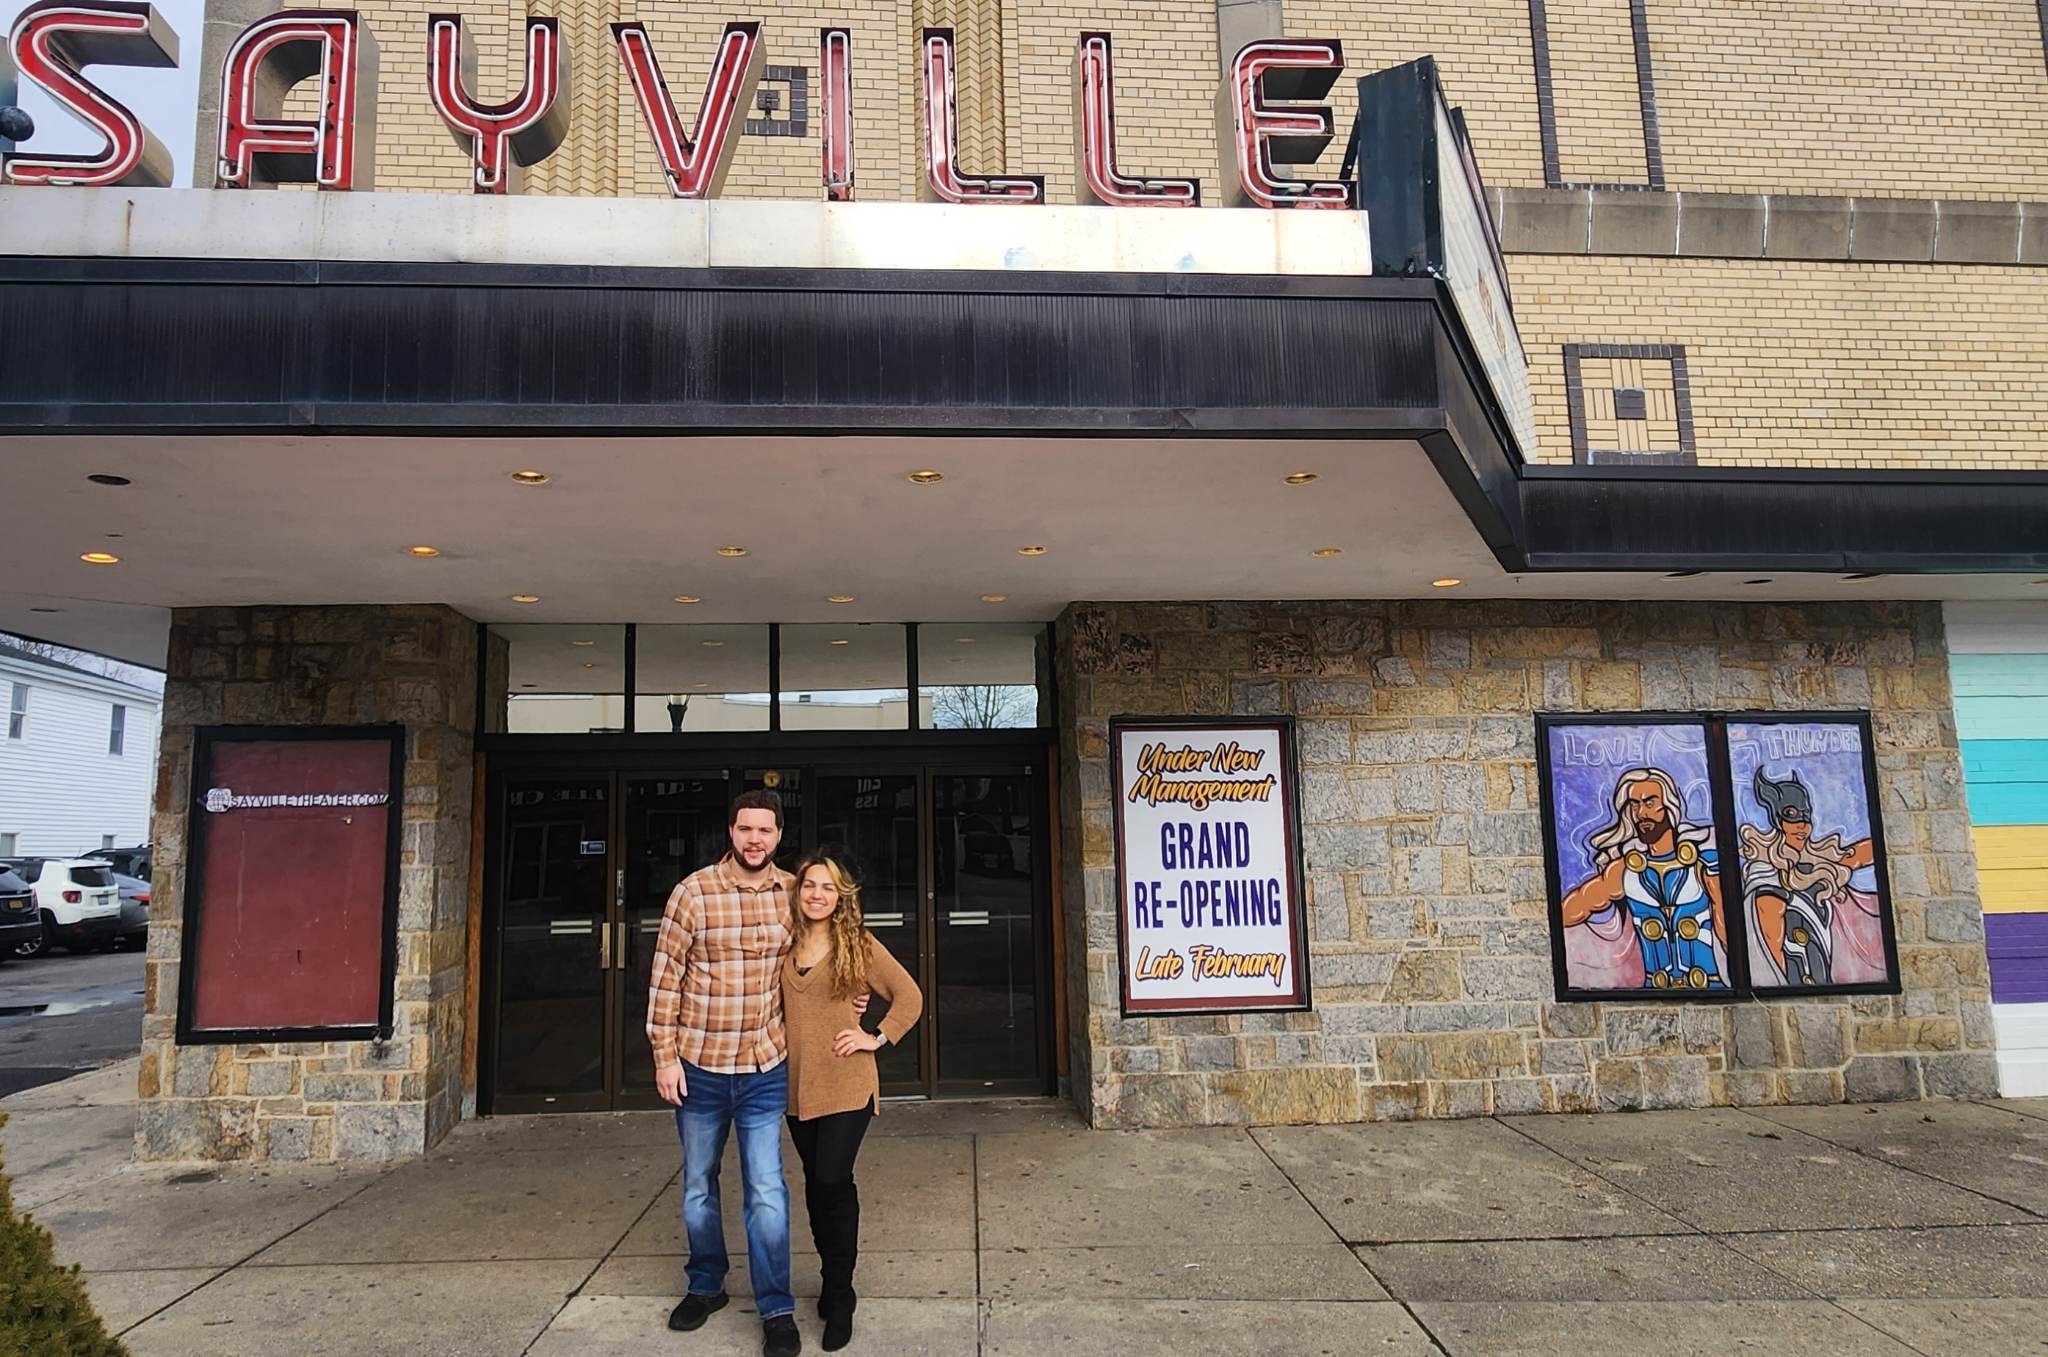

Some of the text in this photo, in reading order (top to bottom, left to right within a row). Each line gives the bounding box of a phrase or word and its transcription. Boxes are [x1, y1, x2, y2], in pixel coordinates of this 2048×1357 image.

[2, 0, 1357, 209] SAYVILLE
[1137, 741, 1264, 774] Under New
[1563, 732, 1644, 767] LOVE
[1761, 727, 1862, 761] THUNDER
[1129, 774, 1276, 811] Management
[1160, 821, 1250, 870] GRAND
[1134, 878, 1282, 928] RE-OPENING
[1135, 944, 1285, 987] Late February
